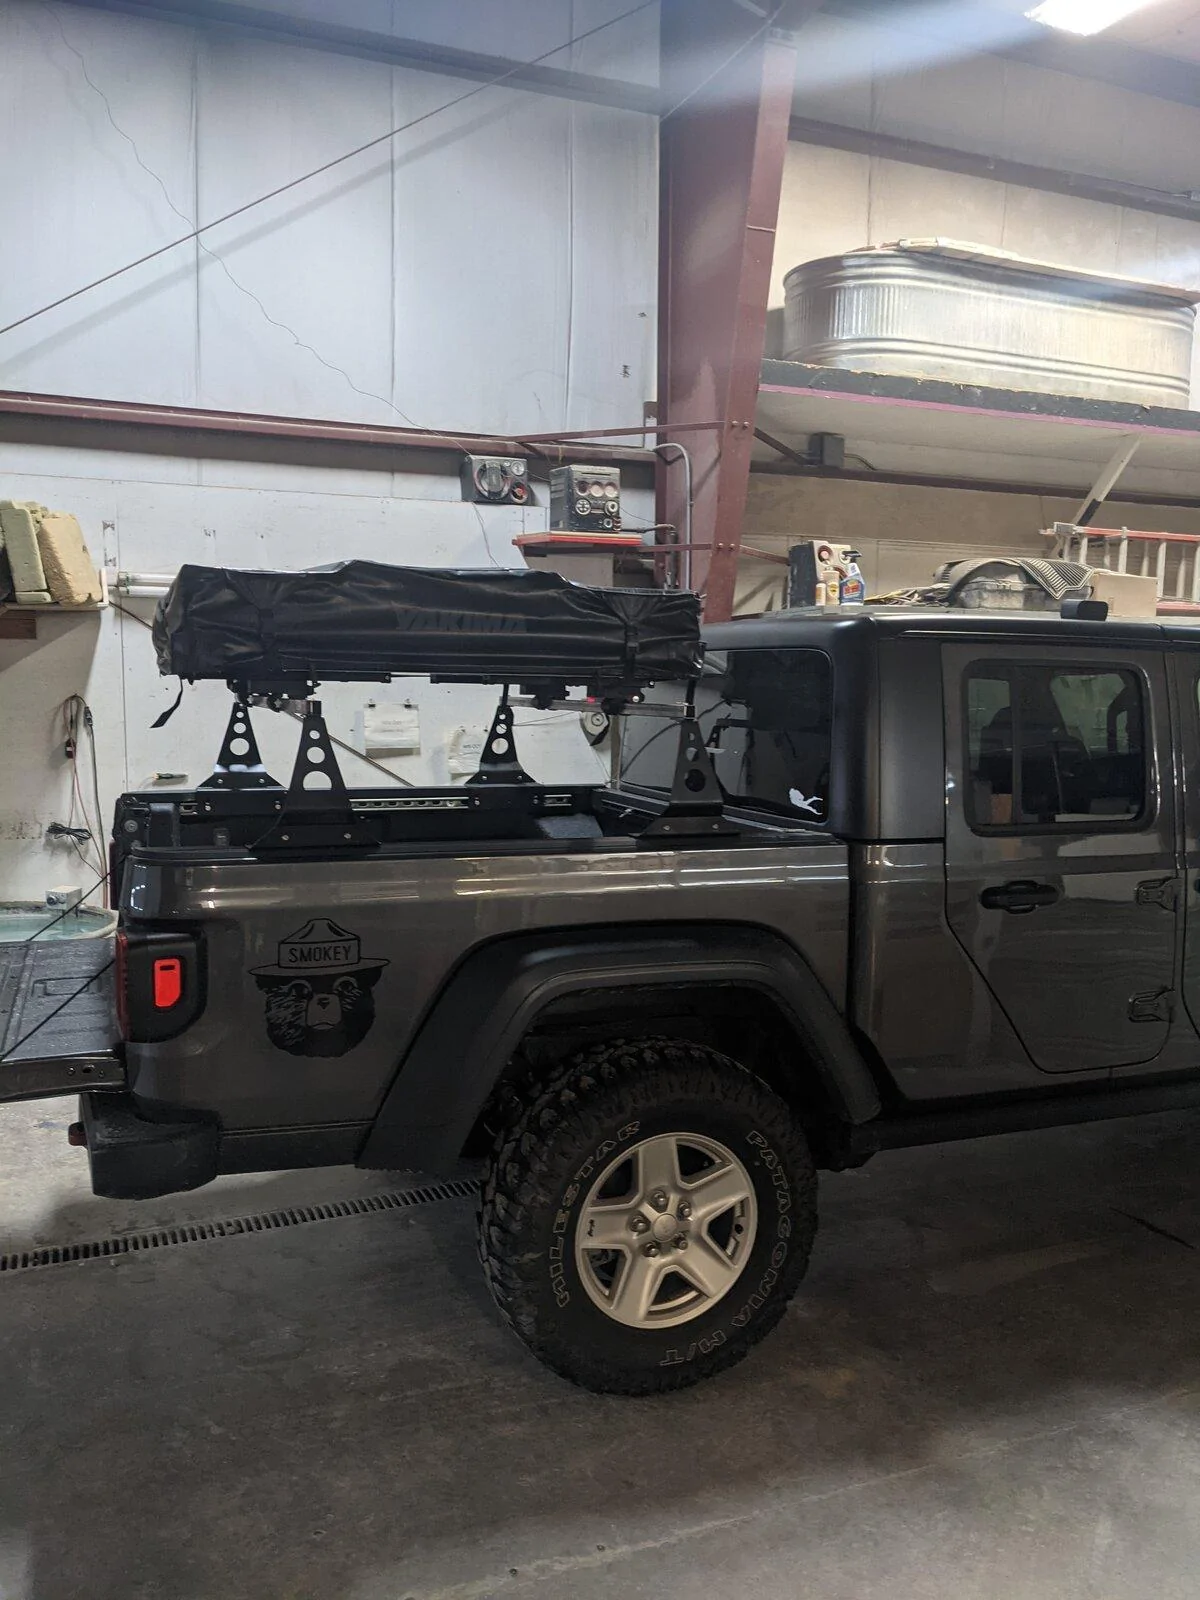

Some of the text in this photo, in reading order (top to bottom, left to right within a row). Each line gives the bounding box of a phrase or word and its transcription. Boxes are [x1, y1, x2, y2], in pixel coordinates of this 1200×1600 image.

[396, 609, 528, 633] YAKIMA
[288, 945, 352, 963] SMOKEY
[549, 1120, 640, 1307] MILESTAR
[659, 1130, 792, 1366] PATAGONIA M/T
